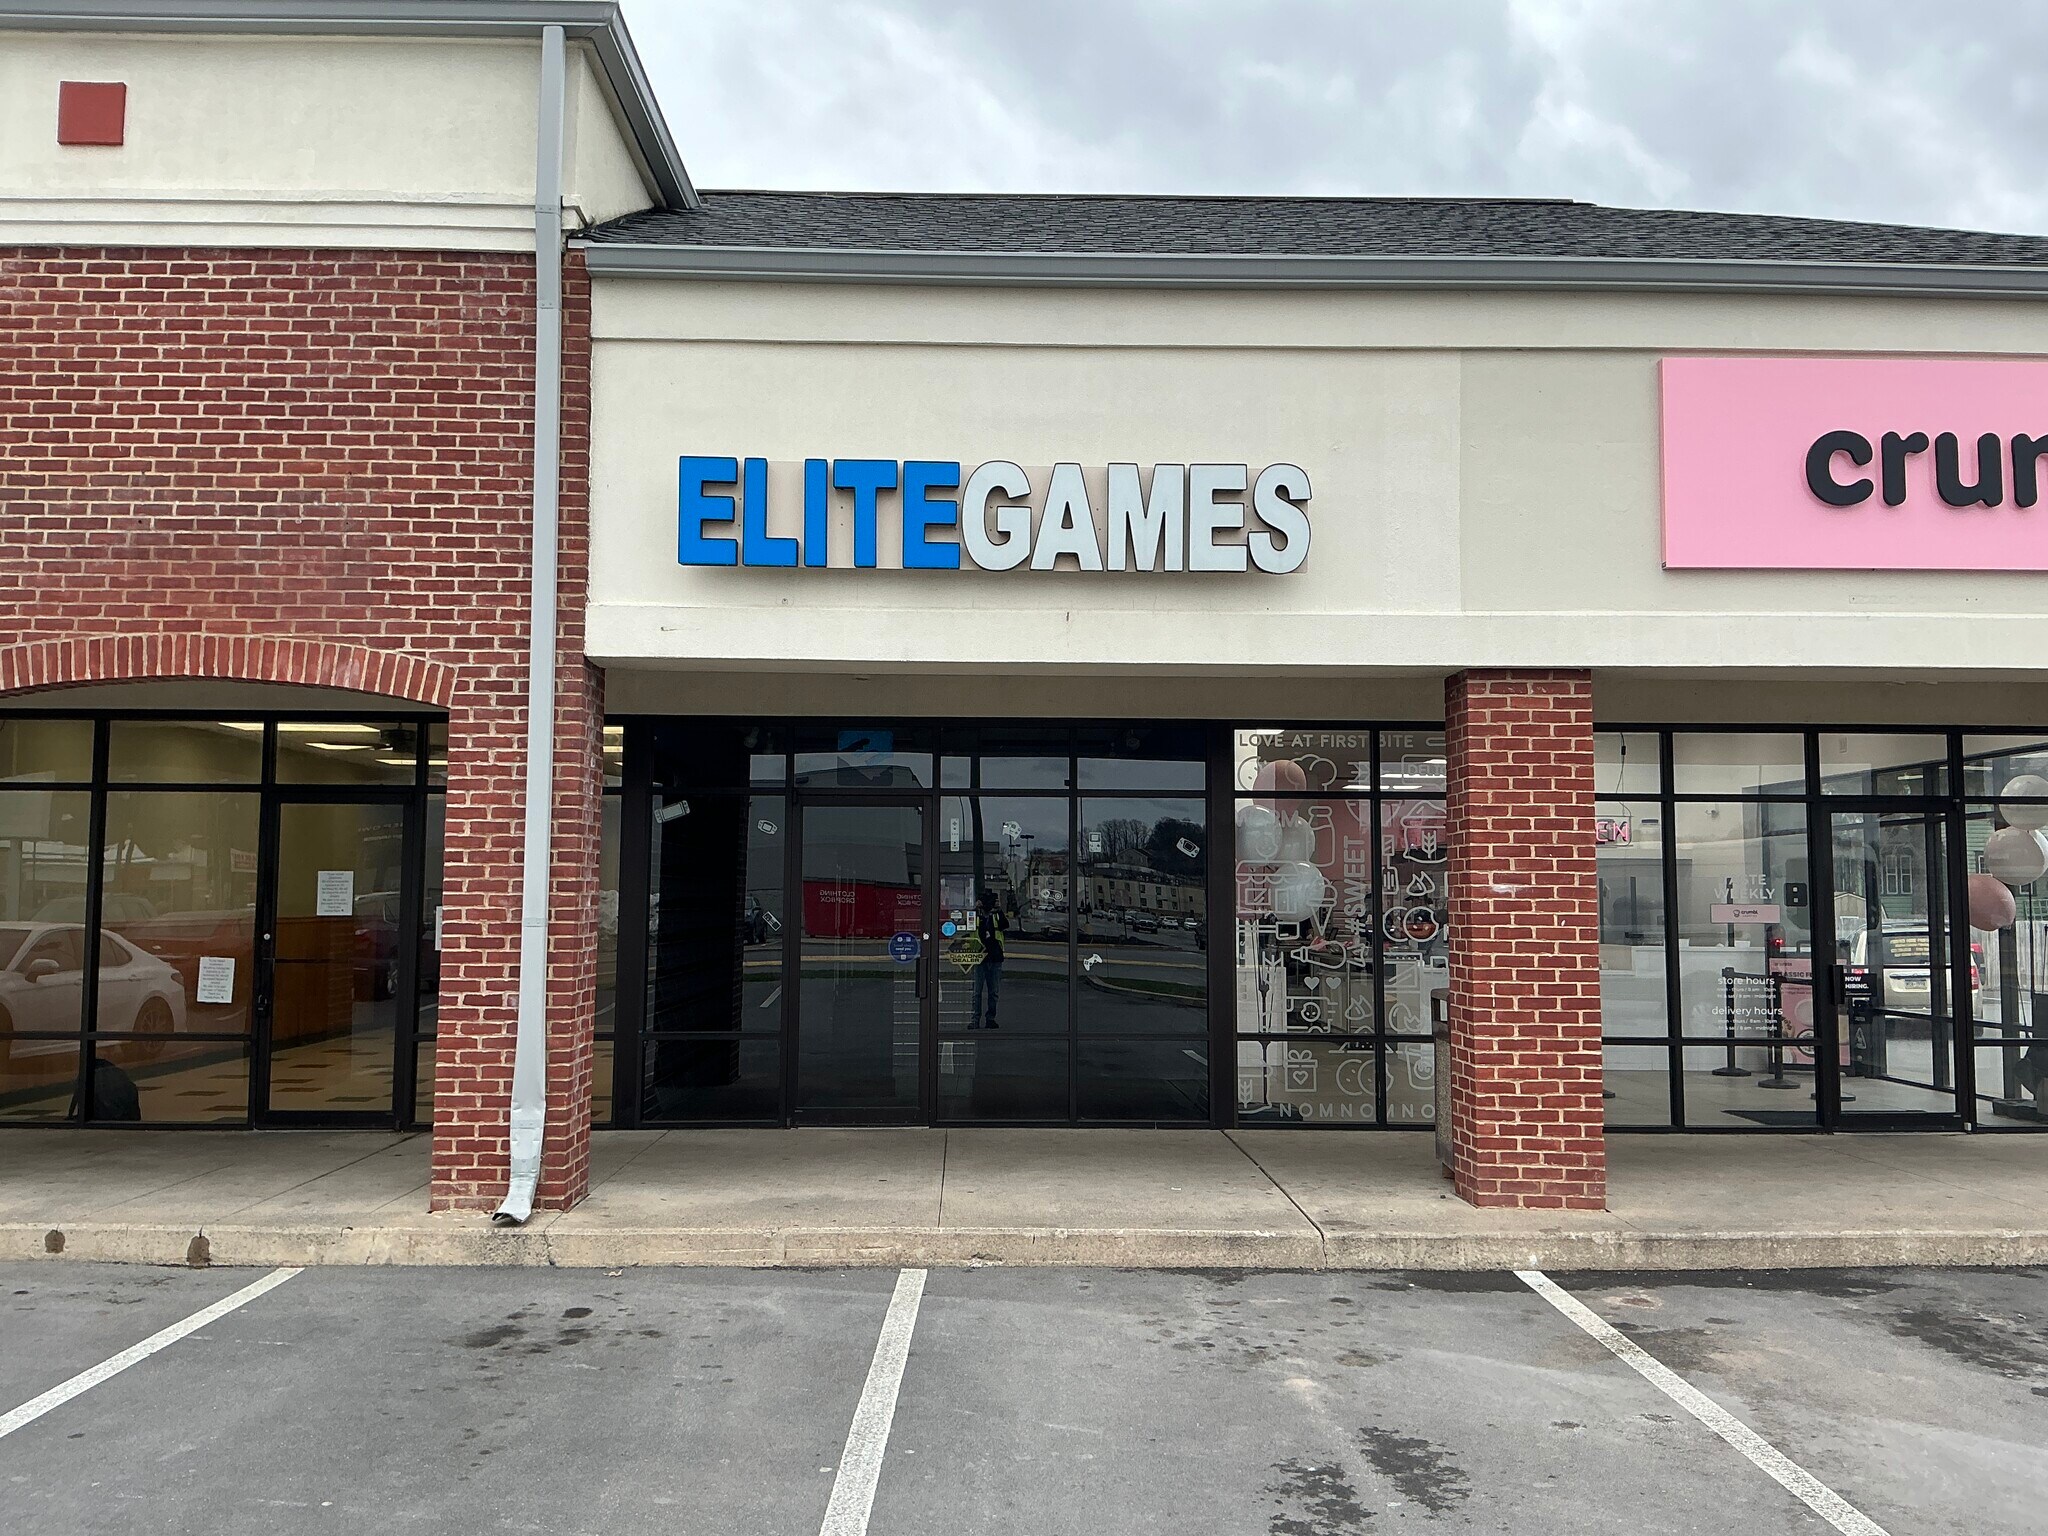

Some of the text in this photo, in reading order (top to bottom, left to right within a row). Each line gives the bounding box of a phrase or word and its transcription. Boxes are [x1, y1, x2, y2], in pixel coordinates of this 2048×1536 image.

[1239, 733, 1284, 747] LOVE
[1291, 734, 1313, 748] AT
[1320, 734, 1369, 748] FIRST
[1344, 835, 1366, 933] #SWEET
[1714, 888, 1775, 900] WEEKLY
[1718, 976, 1775, 985] store hours
[1711, 1006, 1783, 1017] delivery hours
